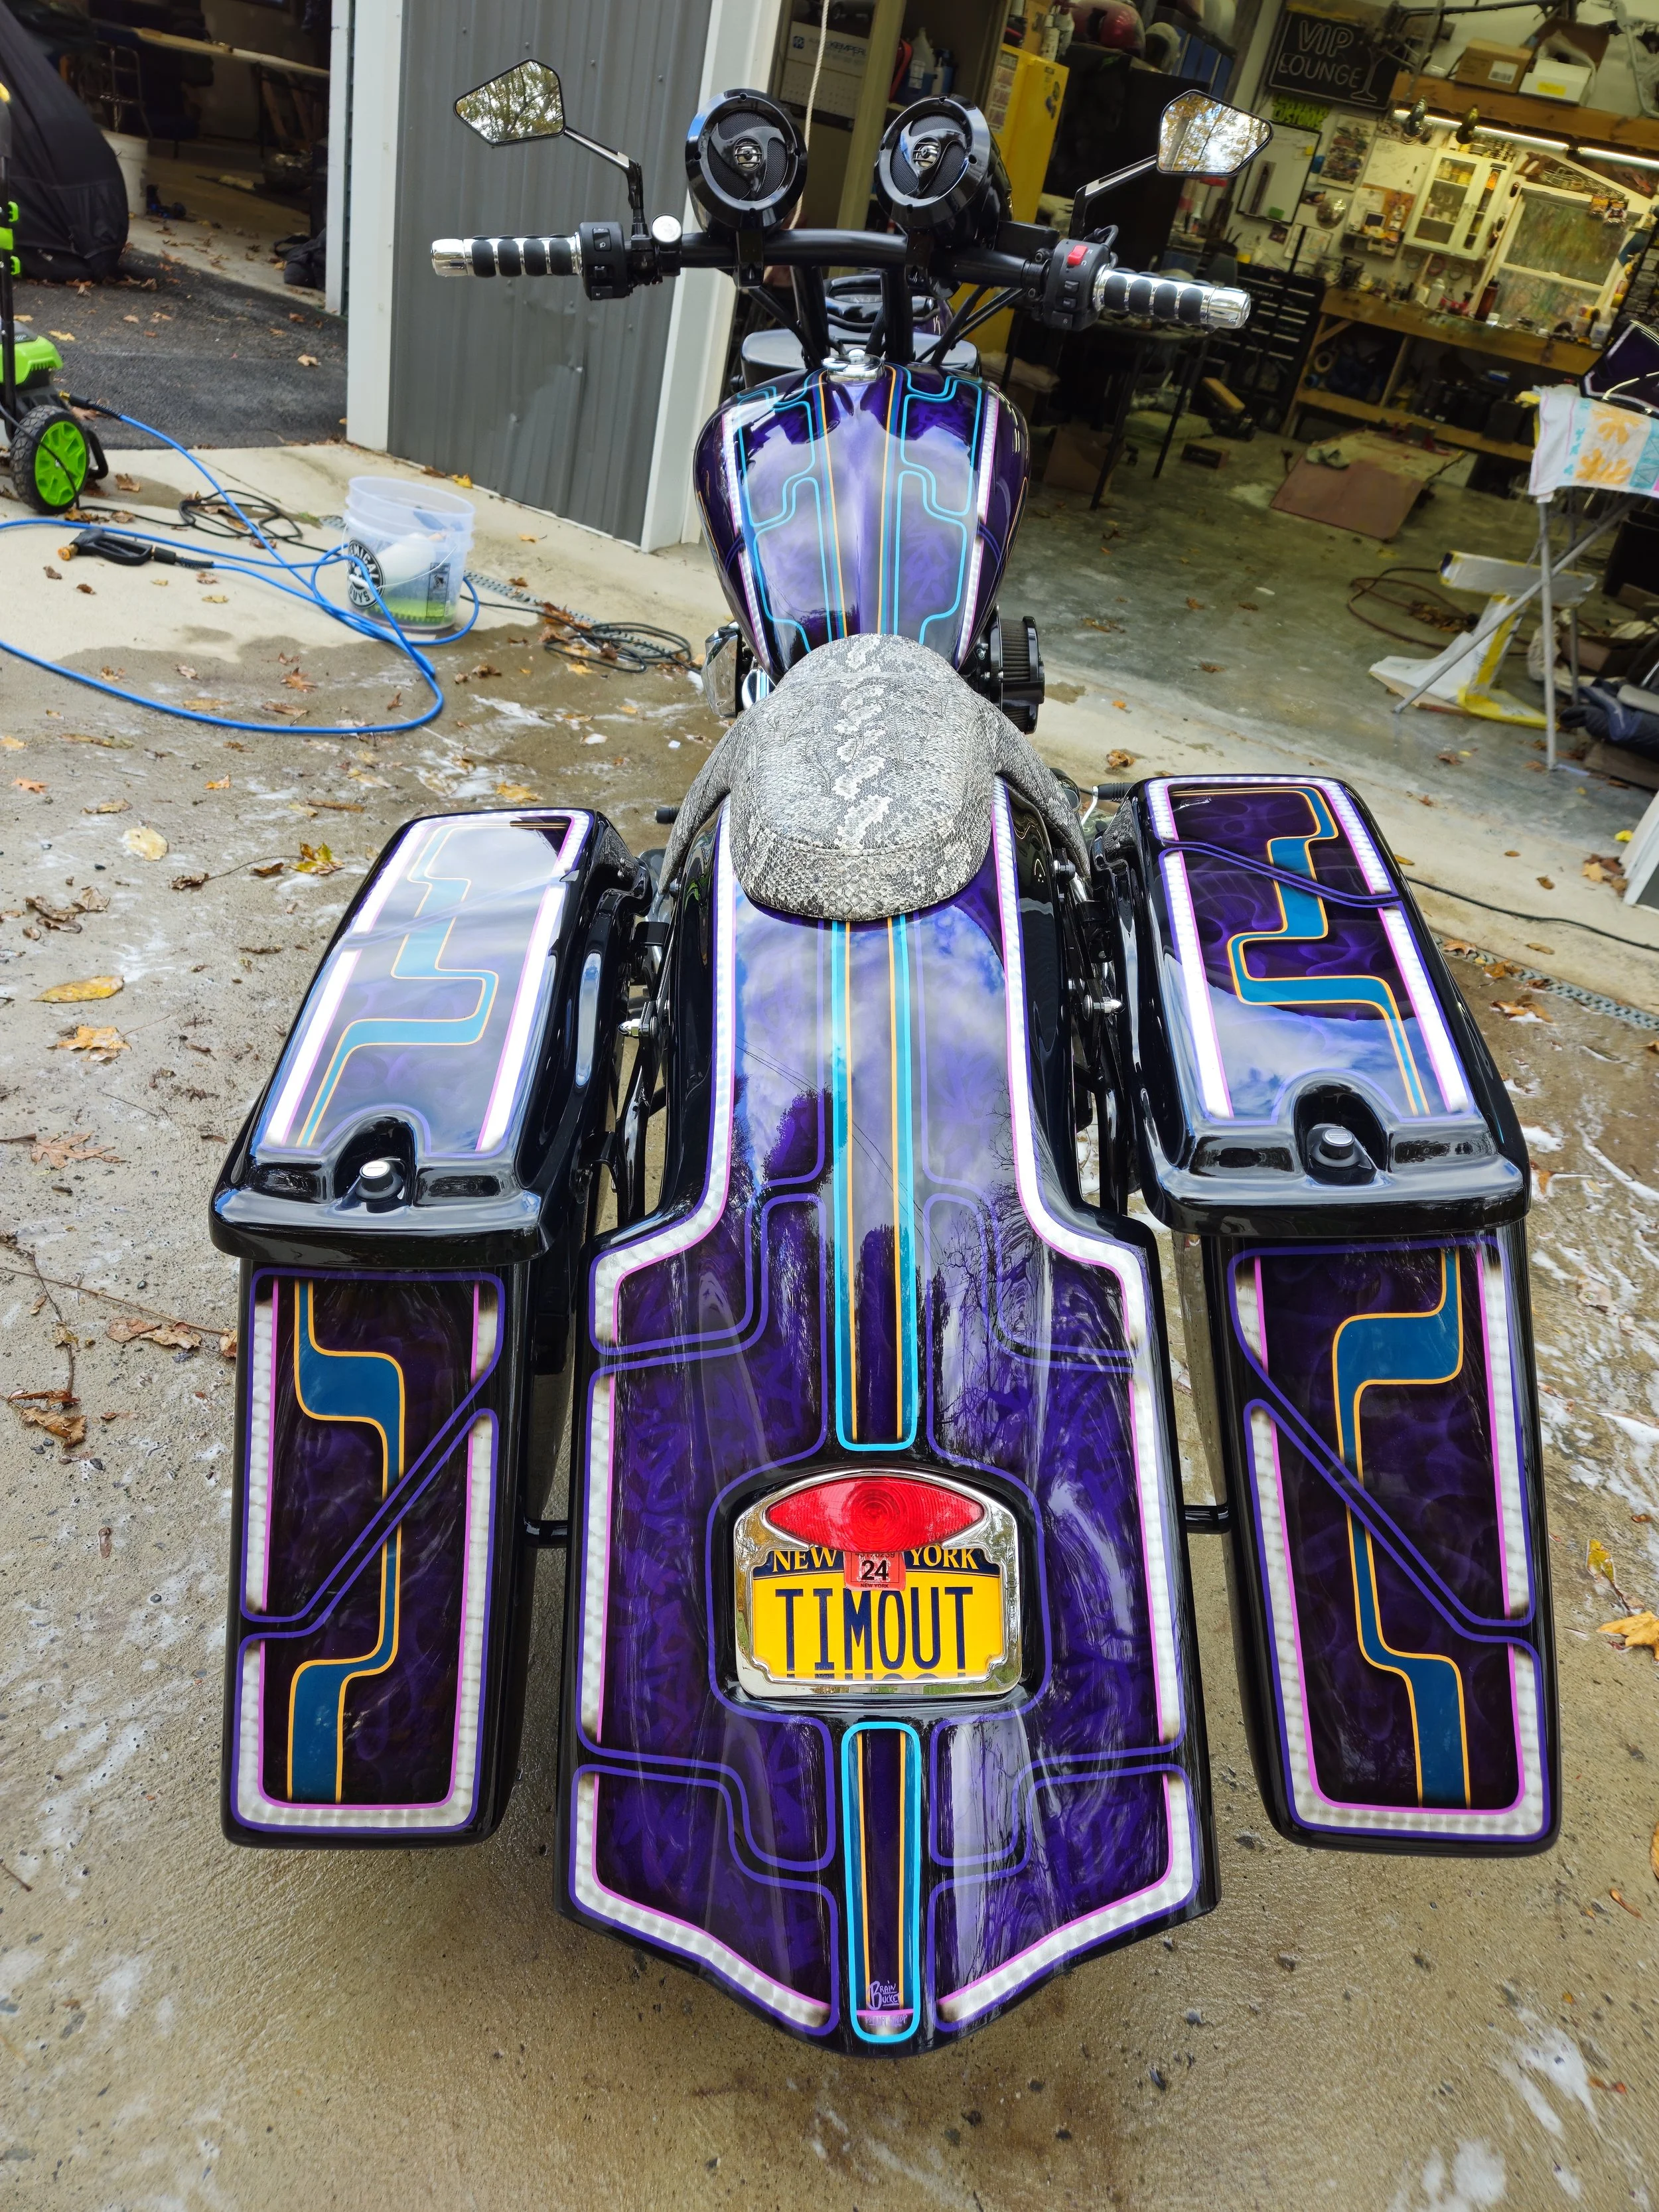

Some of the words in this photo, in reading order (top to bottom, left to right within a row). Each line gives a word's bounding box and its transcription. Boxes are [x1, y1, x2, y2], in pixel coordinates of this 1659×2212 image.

[1299, 19, 1354, 57] VIP
[349, 585, 370, 603] GUYS
[772, 1547, 838, 1572] NEW
[909, 1544, 979, 1570] YORK
[861, 1560, 889, 1581] 24
[775, 1586, 974, 1671] TIMOUT
